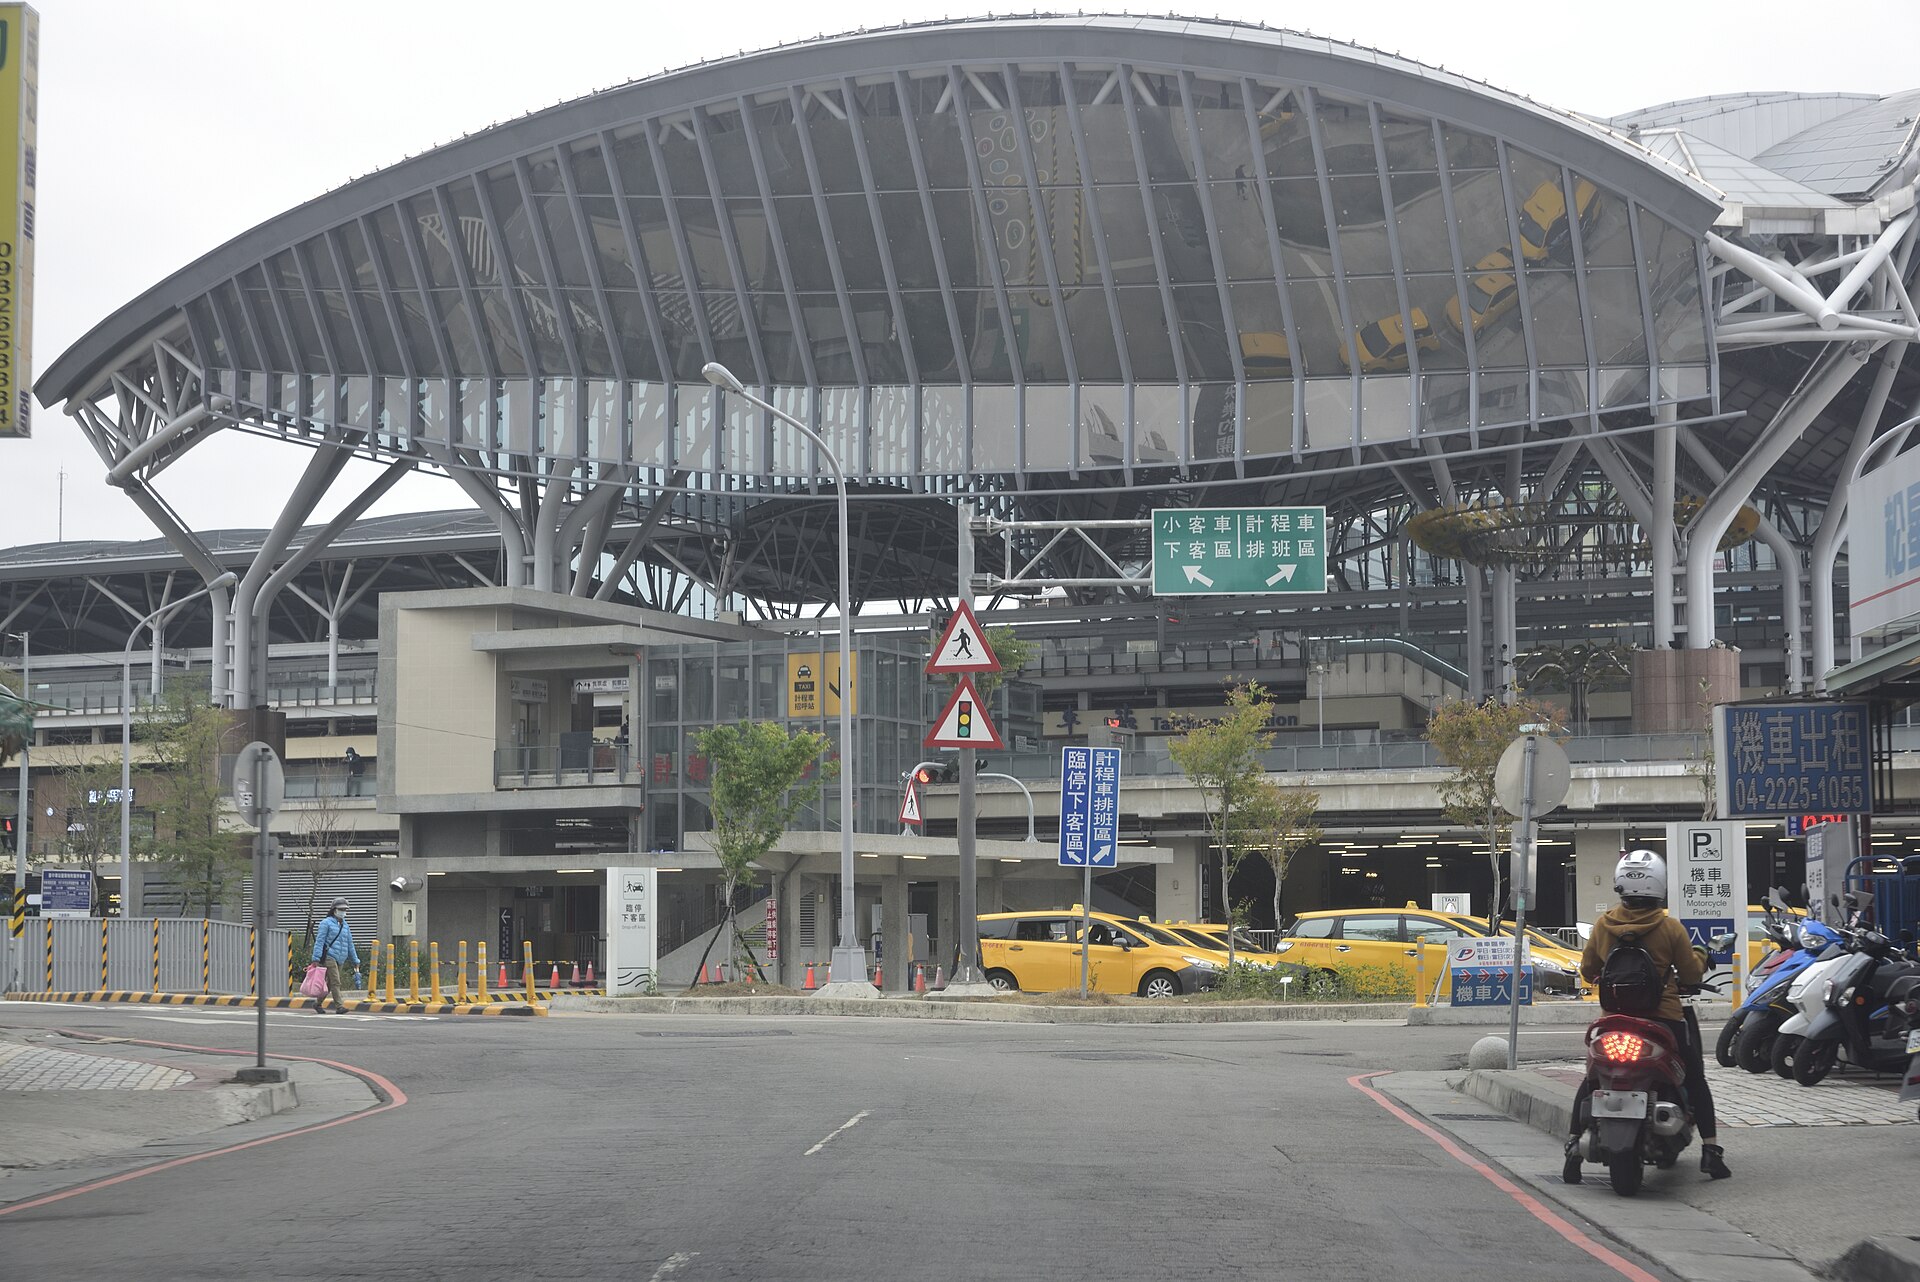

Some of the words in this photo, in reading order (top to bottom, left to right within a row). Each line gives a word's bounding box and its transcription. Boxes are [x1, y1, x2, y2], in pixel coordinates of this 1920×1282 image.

[1163, 515, 1232, 534] 小客車
[1245, 514, 1315, 533] 計程車
[1163, 540, 1232, 559] 下客區
[1246, 540, 1316, 558] 排班區
[794, 694, 814, 702] 計程車
[794, 702, 815, 710] 招呼站
[1732, 709, 1863, 775] 機車出租
[1066, 750, 1087, 850] 臨停下客區
[1093, 751, 1115, 841] 計程車排班區
[1735, 775, 1864, 811] 04-2225-1055
[1693, 833, 1712, 858] P
[1690, 868, 1722, 882] 機車
[1683, 884, 1731, 898] 停車場
[625, 904, 642, 913] 臨停
[1686, 900, 1727, 908] Motorcycle
[1693, 908, 1722, 917] Parking
[622, 914, 646, 922] 下客區
[1456, 985, 1529, 1002] 機車入口
